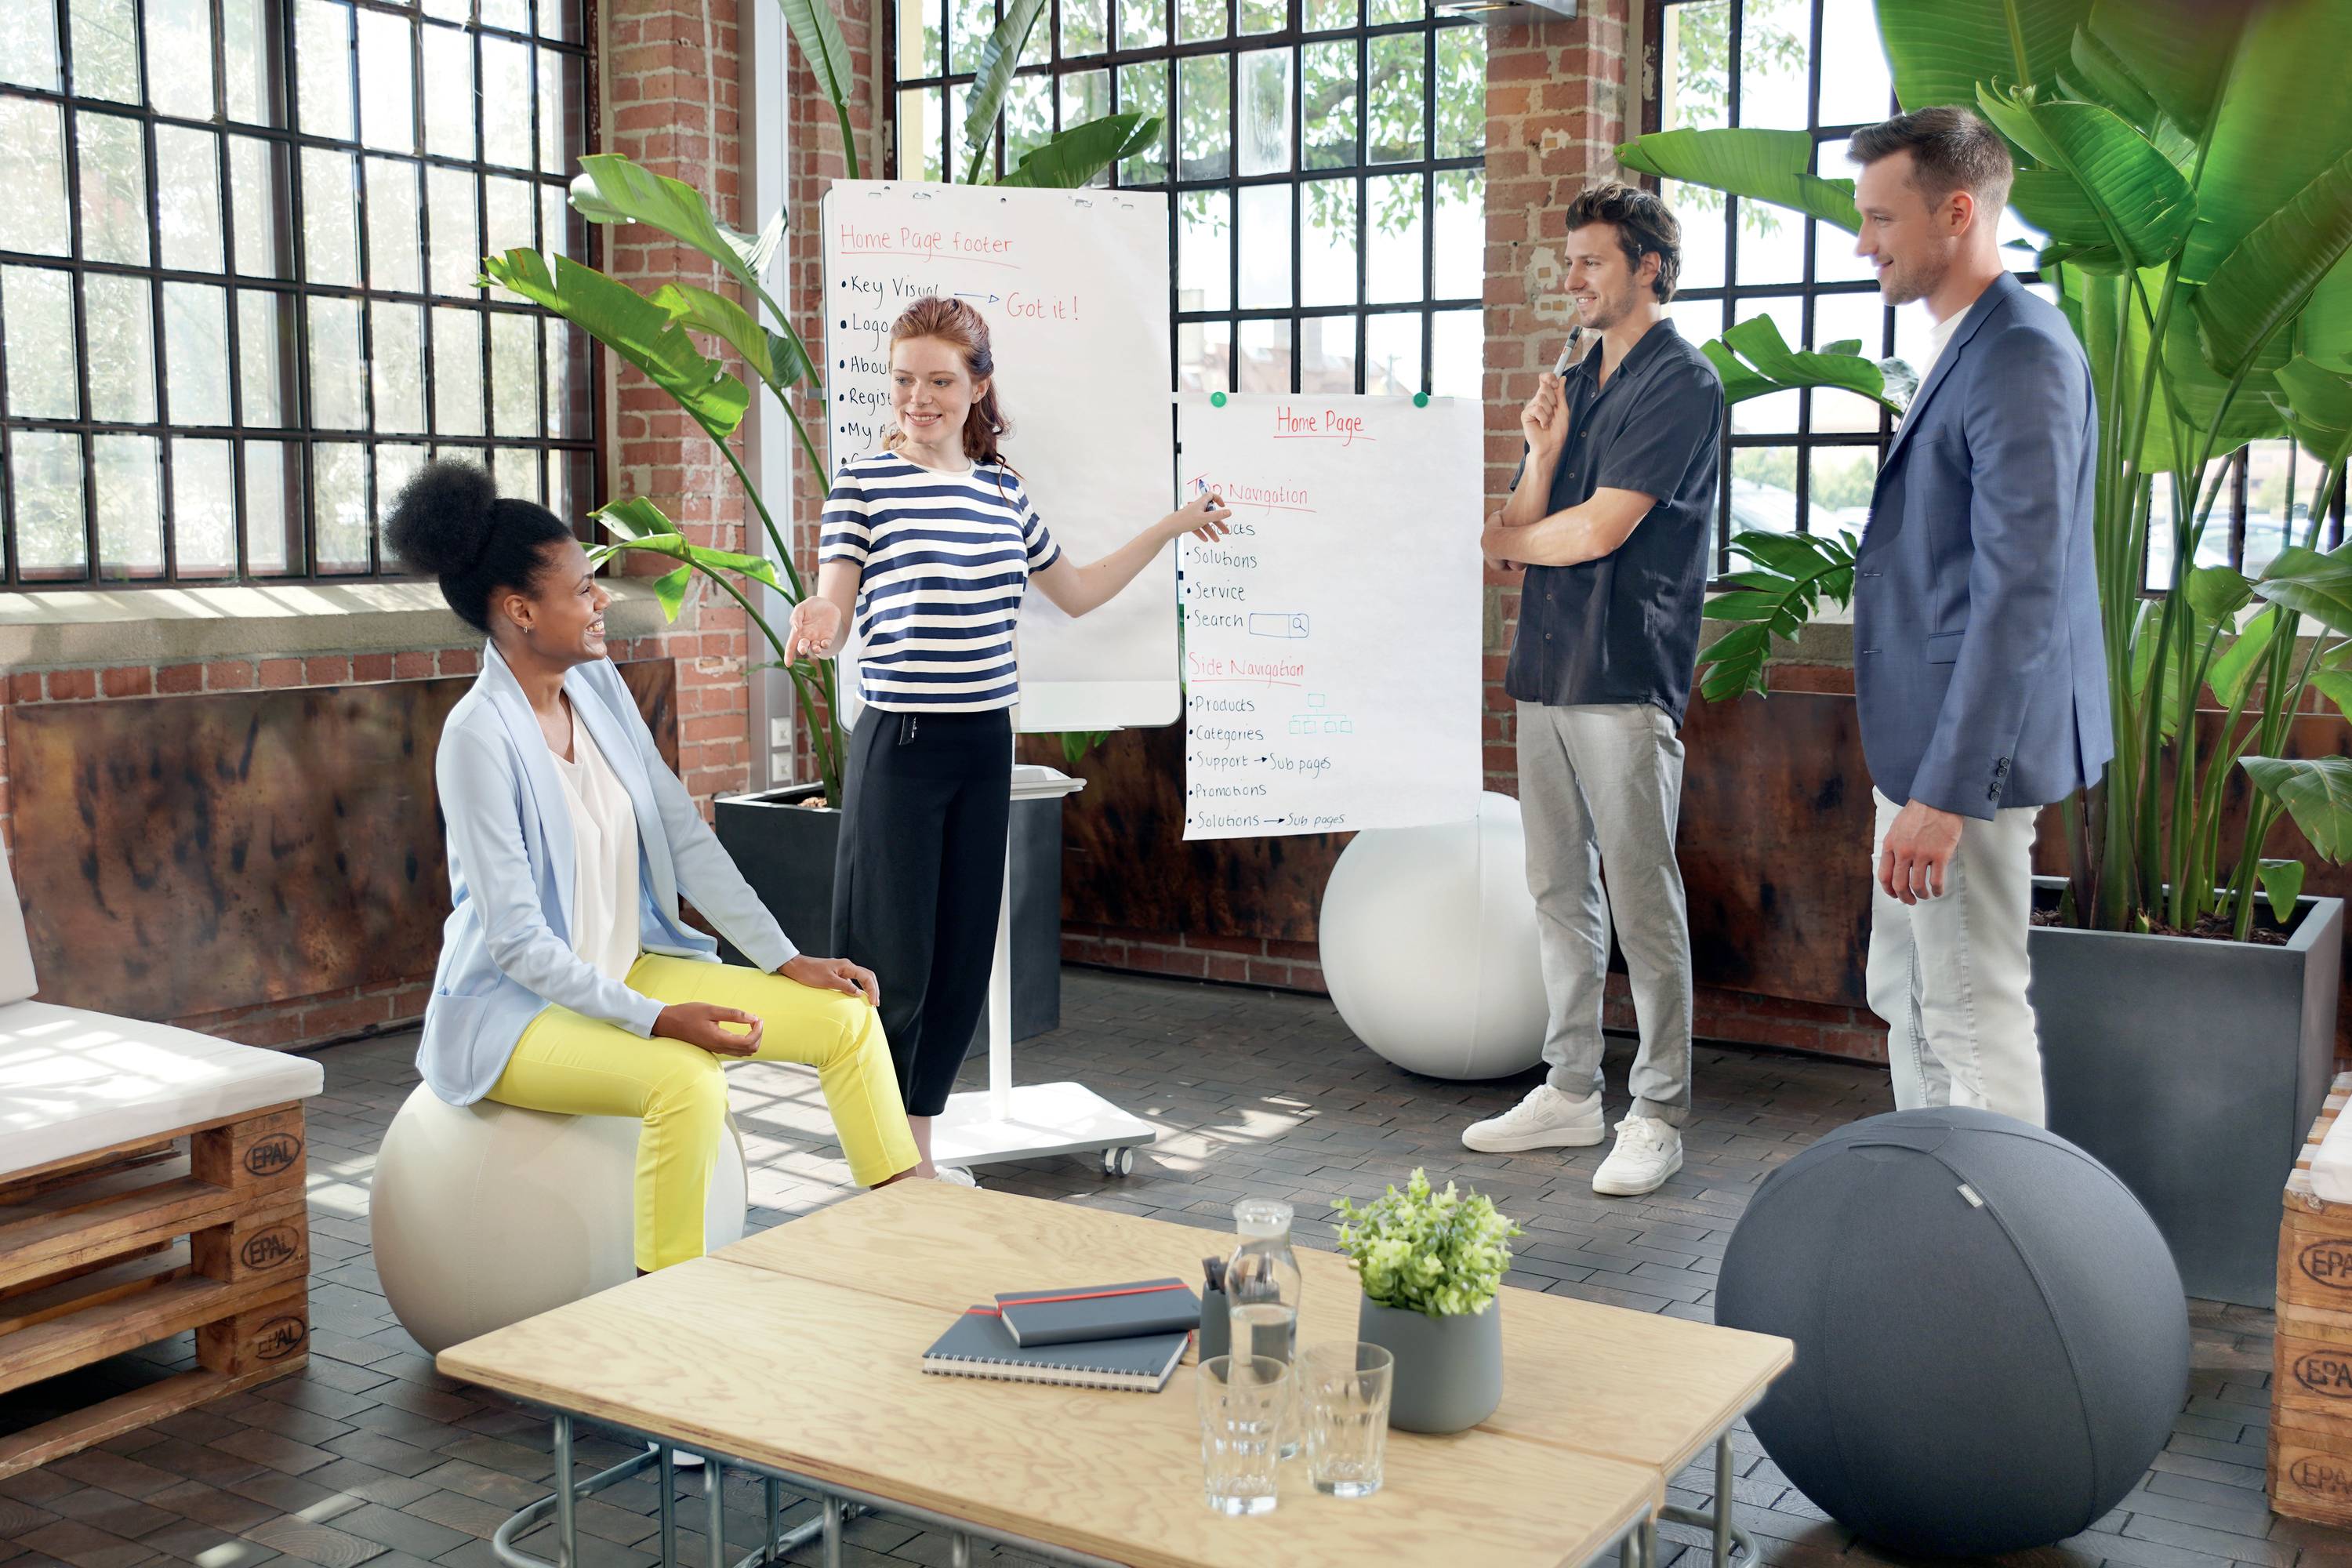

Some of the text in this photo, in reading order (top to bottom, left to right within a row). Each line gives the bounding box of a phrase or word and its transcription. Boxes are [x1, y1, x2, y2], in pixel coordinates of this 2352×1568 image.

[840, 224, 1012, 262] Home Page footer
[851, 275, 883, 310] Key
[1007, 292, 1048, 319] Got
[852, 313, 888, 352] Logo
[848, 422, 872, 450] My
[1276, 406, 1364, 446] Home Page
[1230, 478, 1308, 516] Navigation
[1194, 546, 1258, 568] Solutions
[1195, 580, 1246, 601] Service
[1193, 609, 1243, 627] Search
[1189, 652, 1304, 688] Side Navigation
[1196, 695, 1255, 713] Products
[1196, 724, 1264, 750] Categories
[1196, 751, 1331, 779] Support Sub pages
[1196, 781, 1267, 798] Promotions
[1197, 811, 1346, 829] Solutions Sub pages
[252, 1141, 292, 1171] EPAL
[249, 1232, 292, 1265] EPAL
